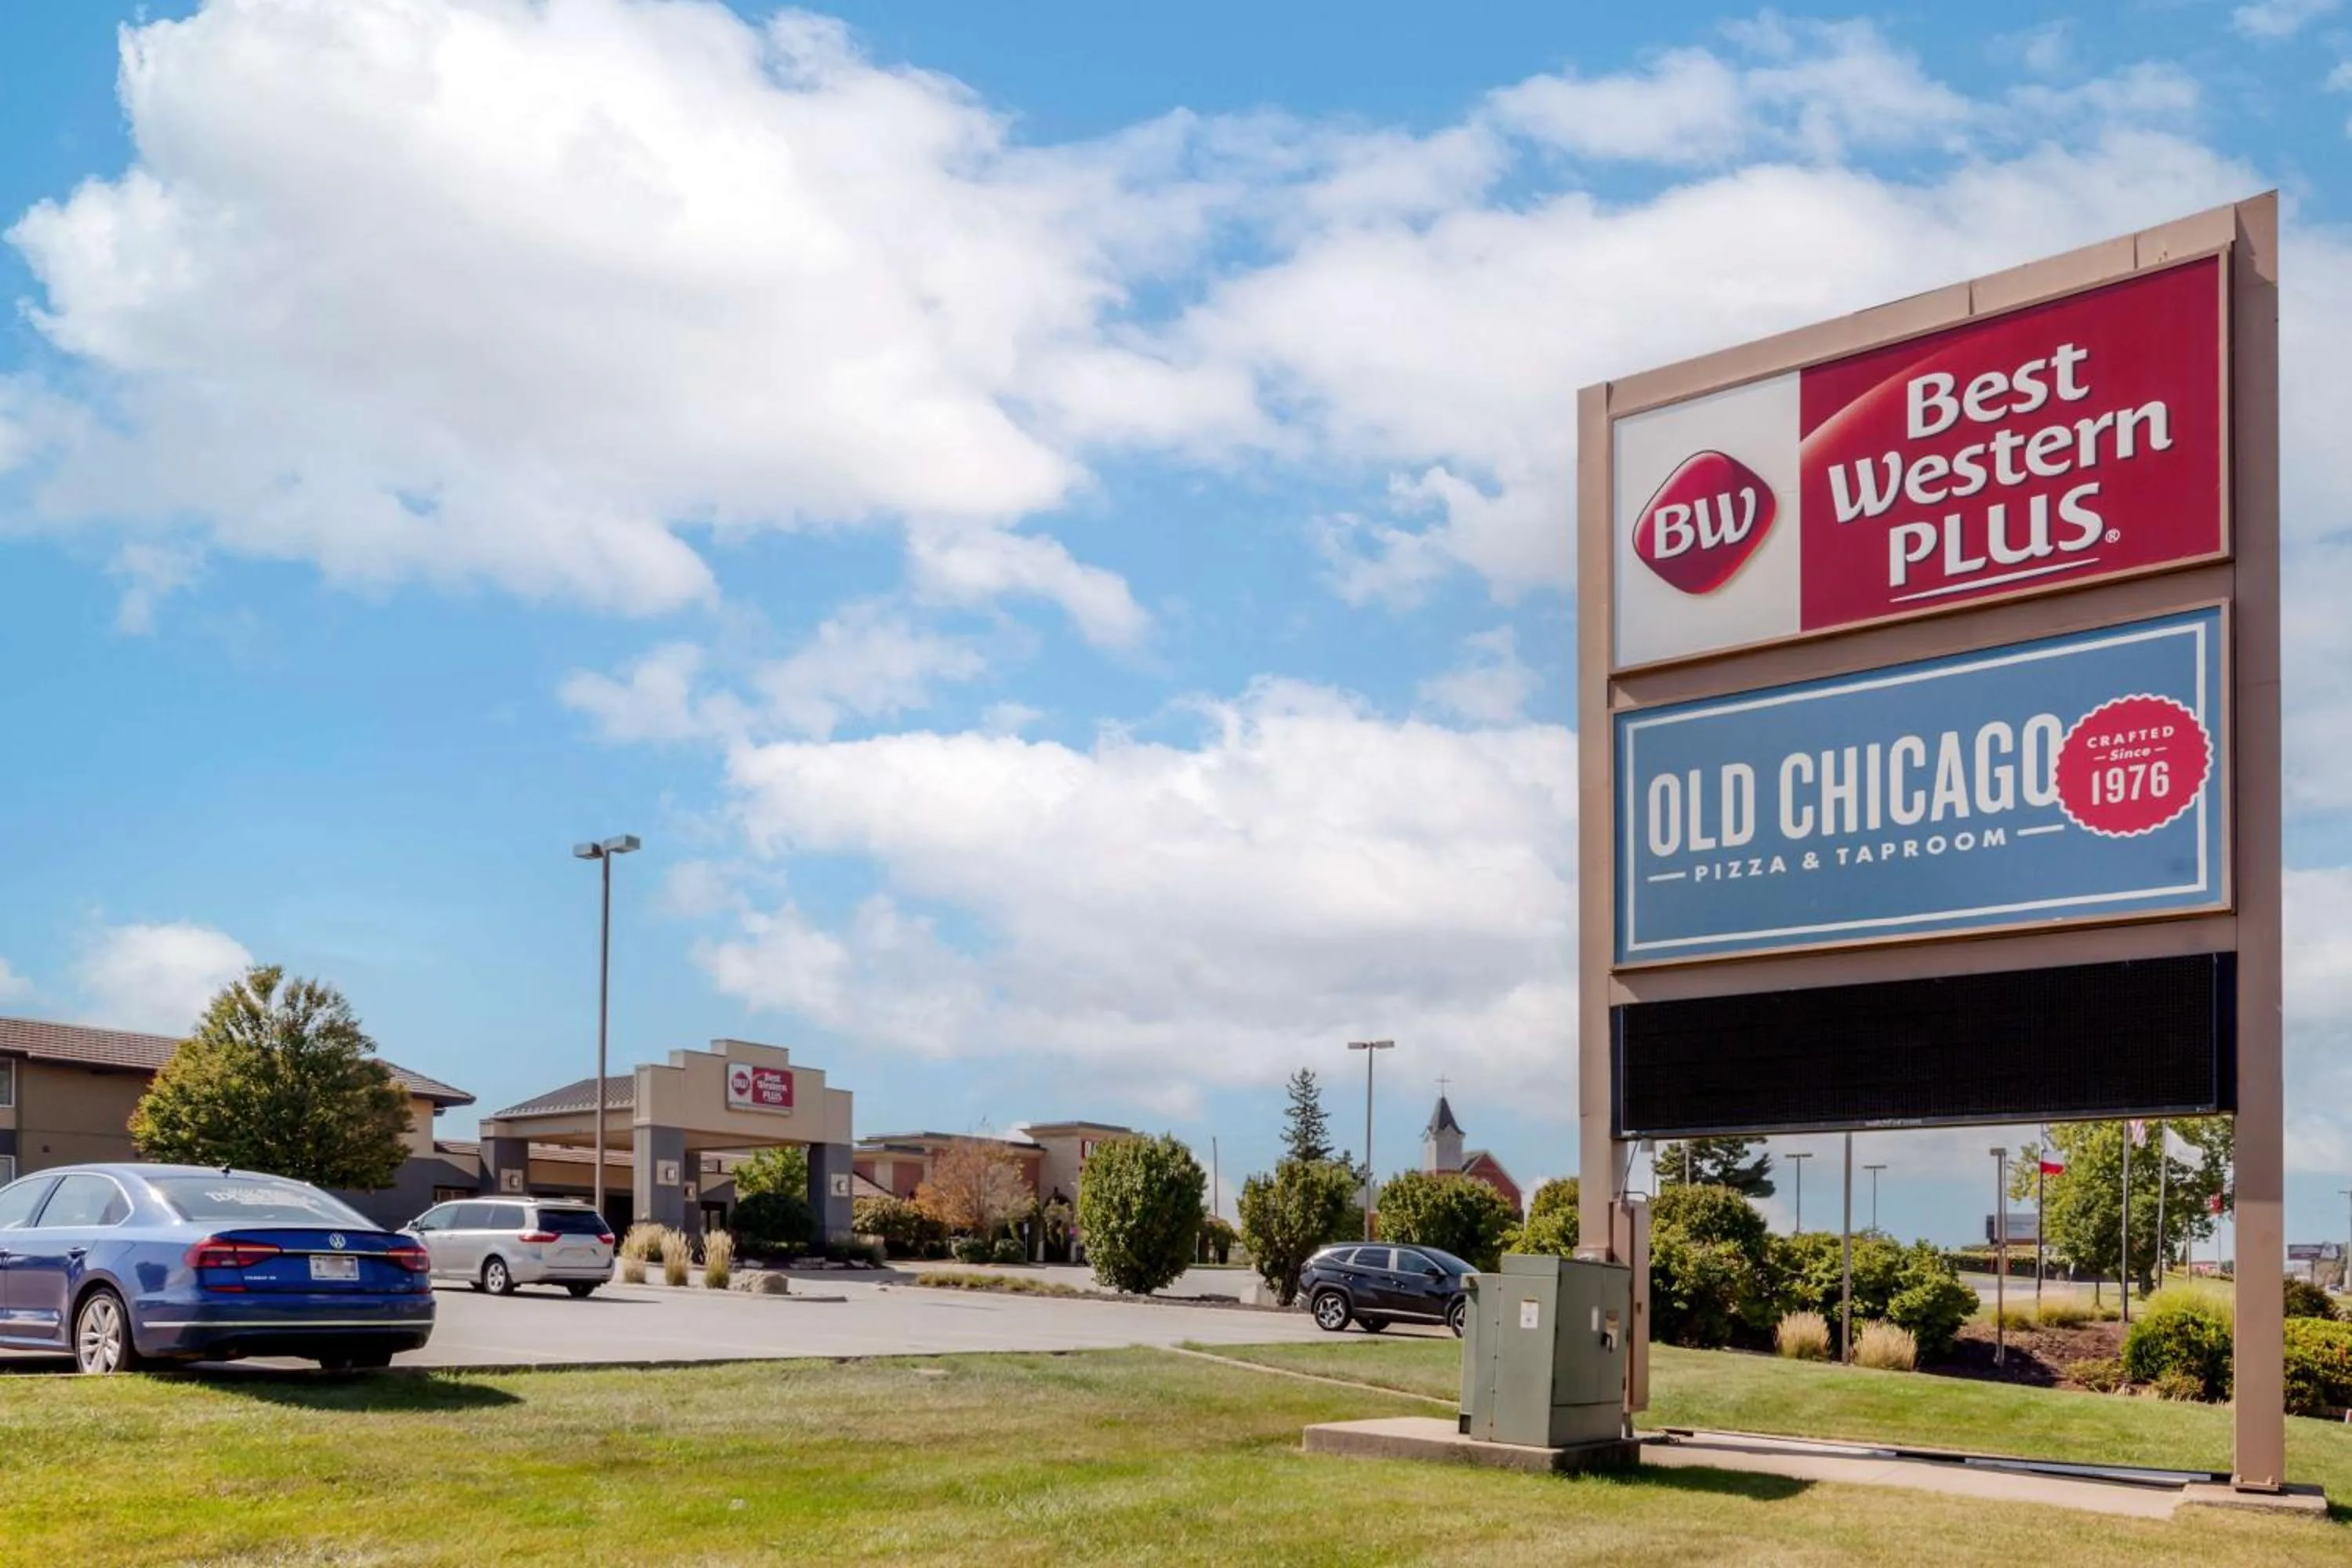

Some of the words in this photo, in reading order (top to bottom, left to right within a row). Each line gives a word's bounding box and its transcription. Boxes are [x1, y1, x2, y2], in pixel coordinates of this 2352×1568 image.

[1906, 343, 2091, 441] Best
[1828, 400, 2173, 524] Western
[1653, 487, 1758, 560] BW
[2086, 725, 2175, 749] CRAFTED
[2109, 747, 2151, 761] Since
[1647, 762, 1756, 858] OLD
[1778, 713, 2063, 840] CHICAGO
[2091, 760, 2170, 806] 1976
[1694, 855, 1788, 882] PIZZA
[1802, 851, 1820, 870] &
[1835, 827, 2007, 866] TAPROOM
